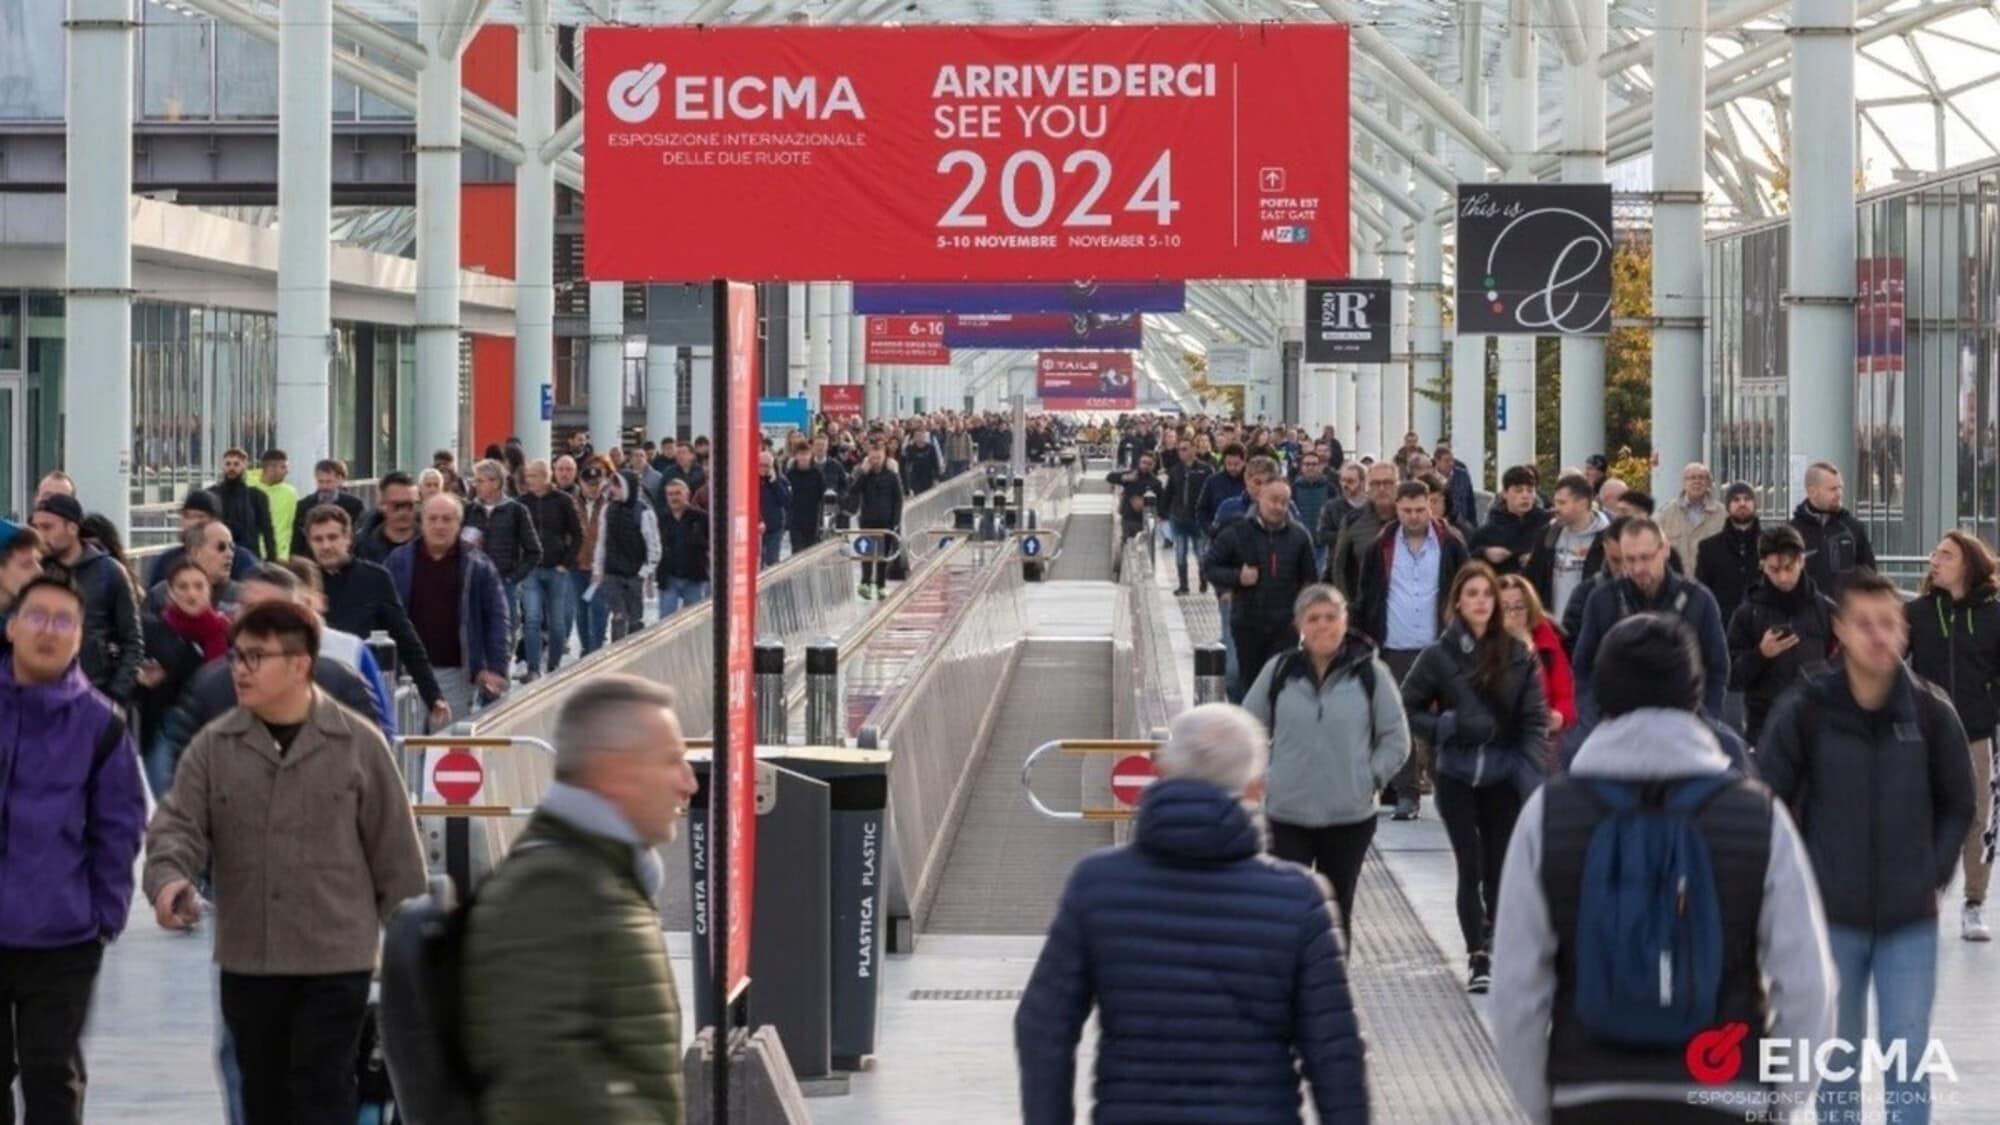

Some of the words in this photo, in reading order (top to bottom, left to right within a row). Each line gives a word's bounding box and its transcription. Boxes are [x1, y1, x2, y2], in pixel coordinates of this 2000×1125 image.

[675, 76, 866, 120] EICMA
[931, 63, 1217, 98] ARRIVEDERCI
[934, 104, 1001, 138] SEE
[1015, 104, 1108, 138] YOU
[608, 133, 719, 147] ESPOSIZIONE
[723, 133, 866, 147] INTERNAZIONALE
[663, 151, 713, 165] DELLE
[717, 151, 751, 165] DUE
[755, 151, 812, 165] RUOTE
[936, 148, 1181, 228] 2024
[1461, 191, 1500, 219] this
[1503, 201, 1525, 217] is
[936, 235, 970, 248] 5-10
[974, 235, 1057, 248] NOVEMBRE
[1068, 234, 1145, 248] NOVEMBER
[1149, 234, 1181, 248] 5-10
[1321, 291, 1336, 328] 1920
[1335, 291, 1372, 329] R
[693, 822, 705, 870] PAPER
[862, 822, 877, 886] PLASTIC
[695, 879, 706, 936] CARTA
[858, 896, 874, 978] PLASTICA
